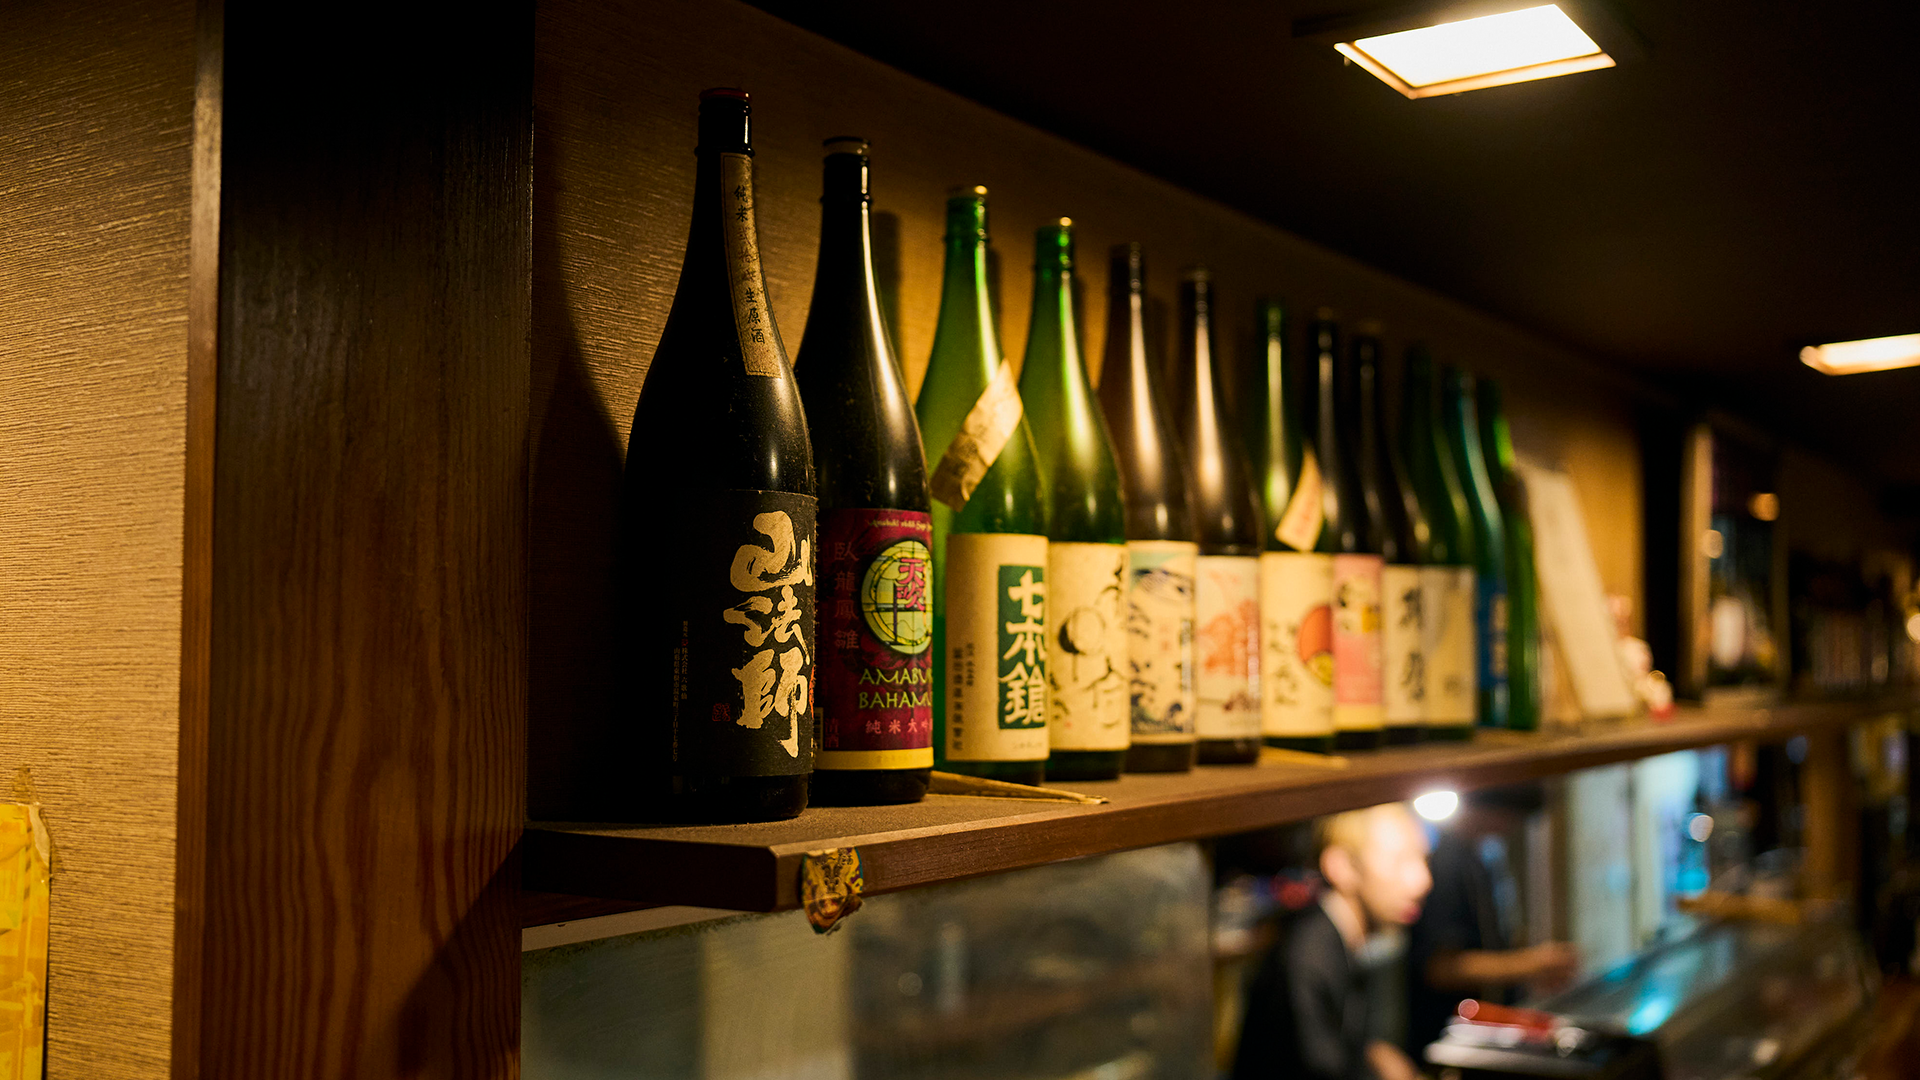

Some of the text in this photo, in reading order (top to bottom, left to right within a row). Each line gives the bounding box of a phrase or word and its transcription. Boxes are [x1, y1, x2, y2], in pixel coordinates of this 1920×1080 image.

[722, 510, 813, 758] 山法師
[896, 557, 926, 612] 天吹
[999, 569, 1047, 726] 七本鎗
